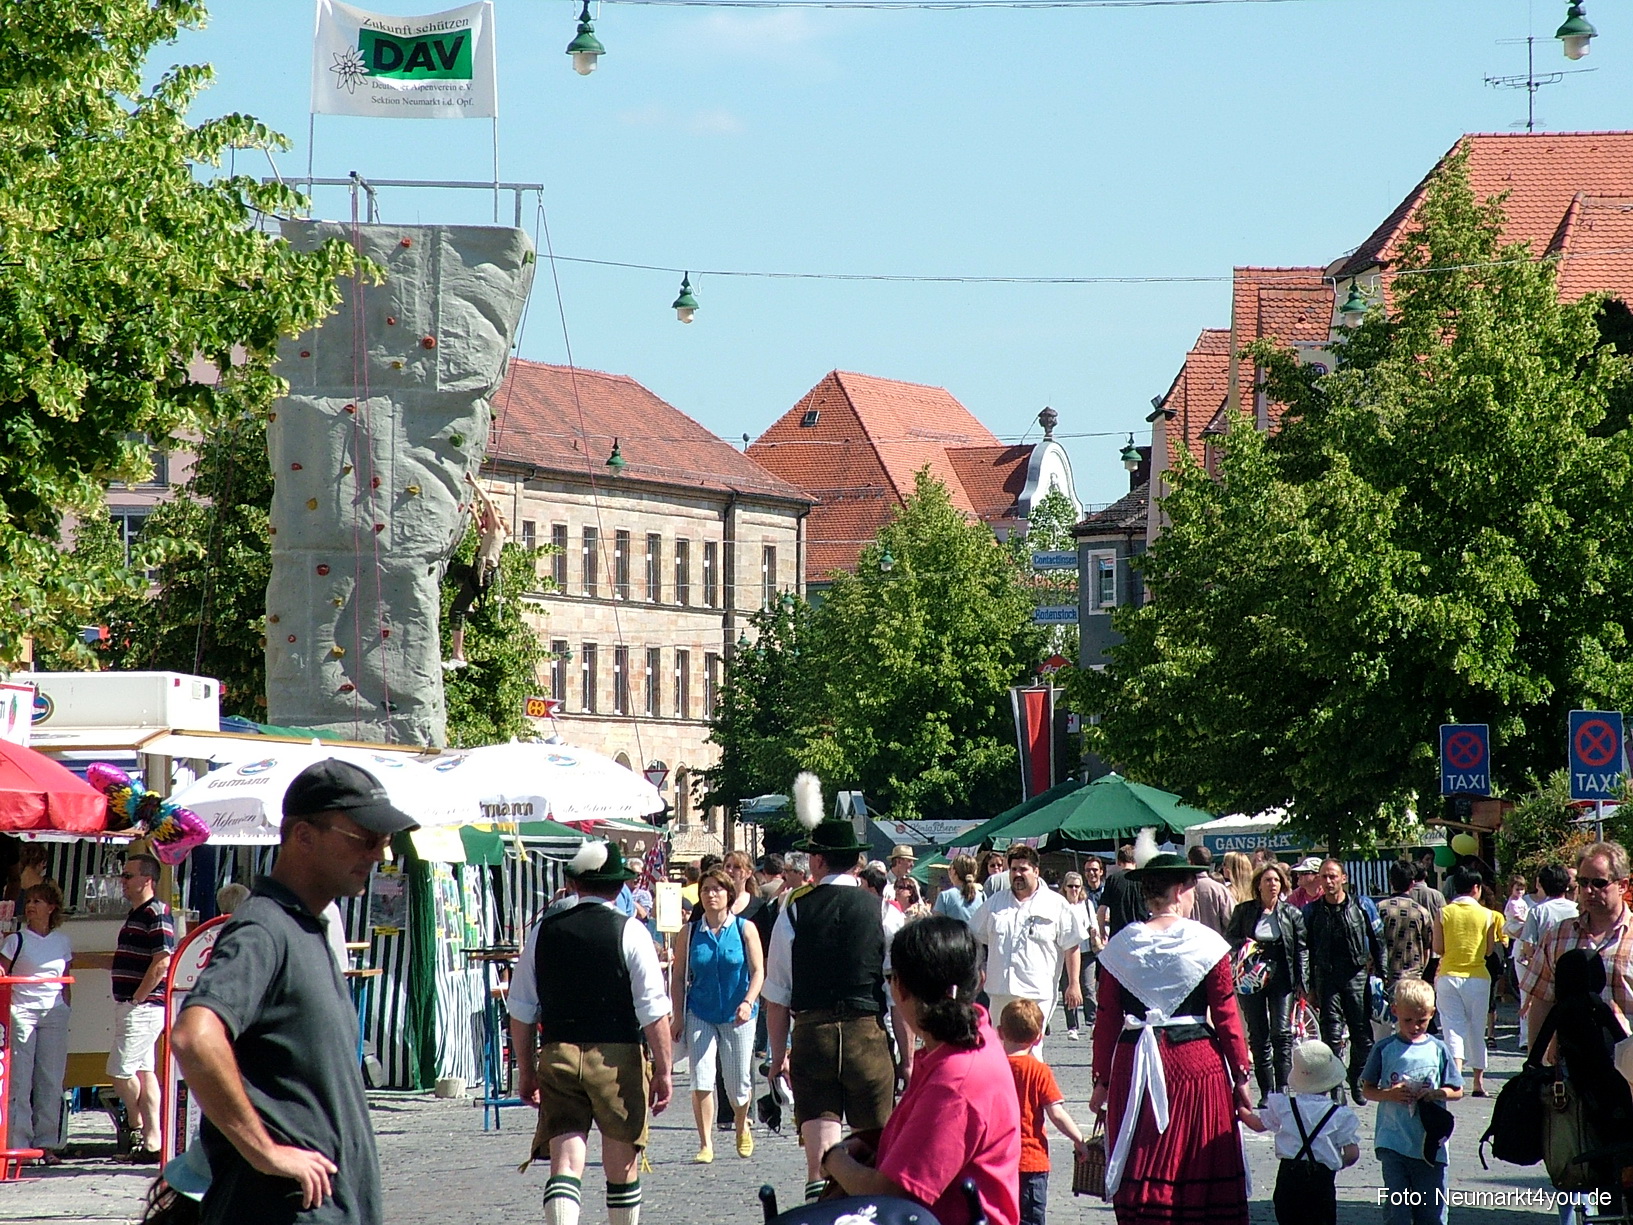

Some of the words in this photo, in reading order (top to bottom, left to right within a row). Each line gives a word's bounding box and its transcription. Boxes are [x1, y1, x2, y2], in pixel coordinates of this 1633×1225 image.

[363, 16, 413, 36] Zukunft
[415, 17, 469, 35] schützen
[373, 36, 465, 73] DAV
[371, 95, 401, 105] Sektion
[402, 97, 441, 106] Neumarkt
[456, 98, 474, 107] Opf.
[1034, 554, 1077, 565] Contactlinsen
[1035, 608, 1077, 620] Rodenstock
[1447, 774, 1485, 790] TAXI
[1575, 773, 1618, 792] TAXI
